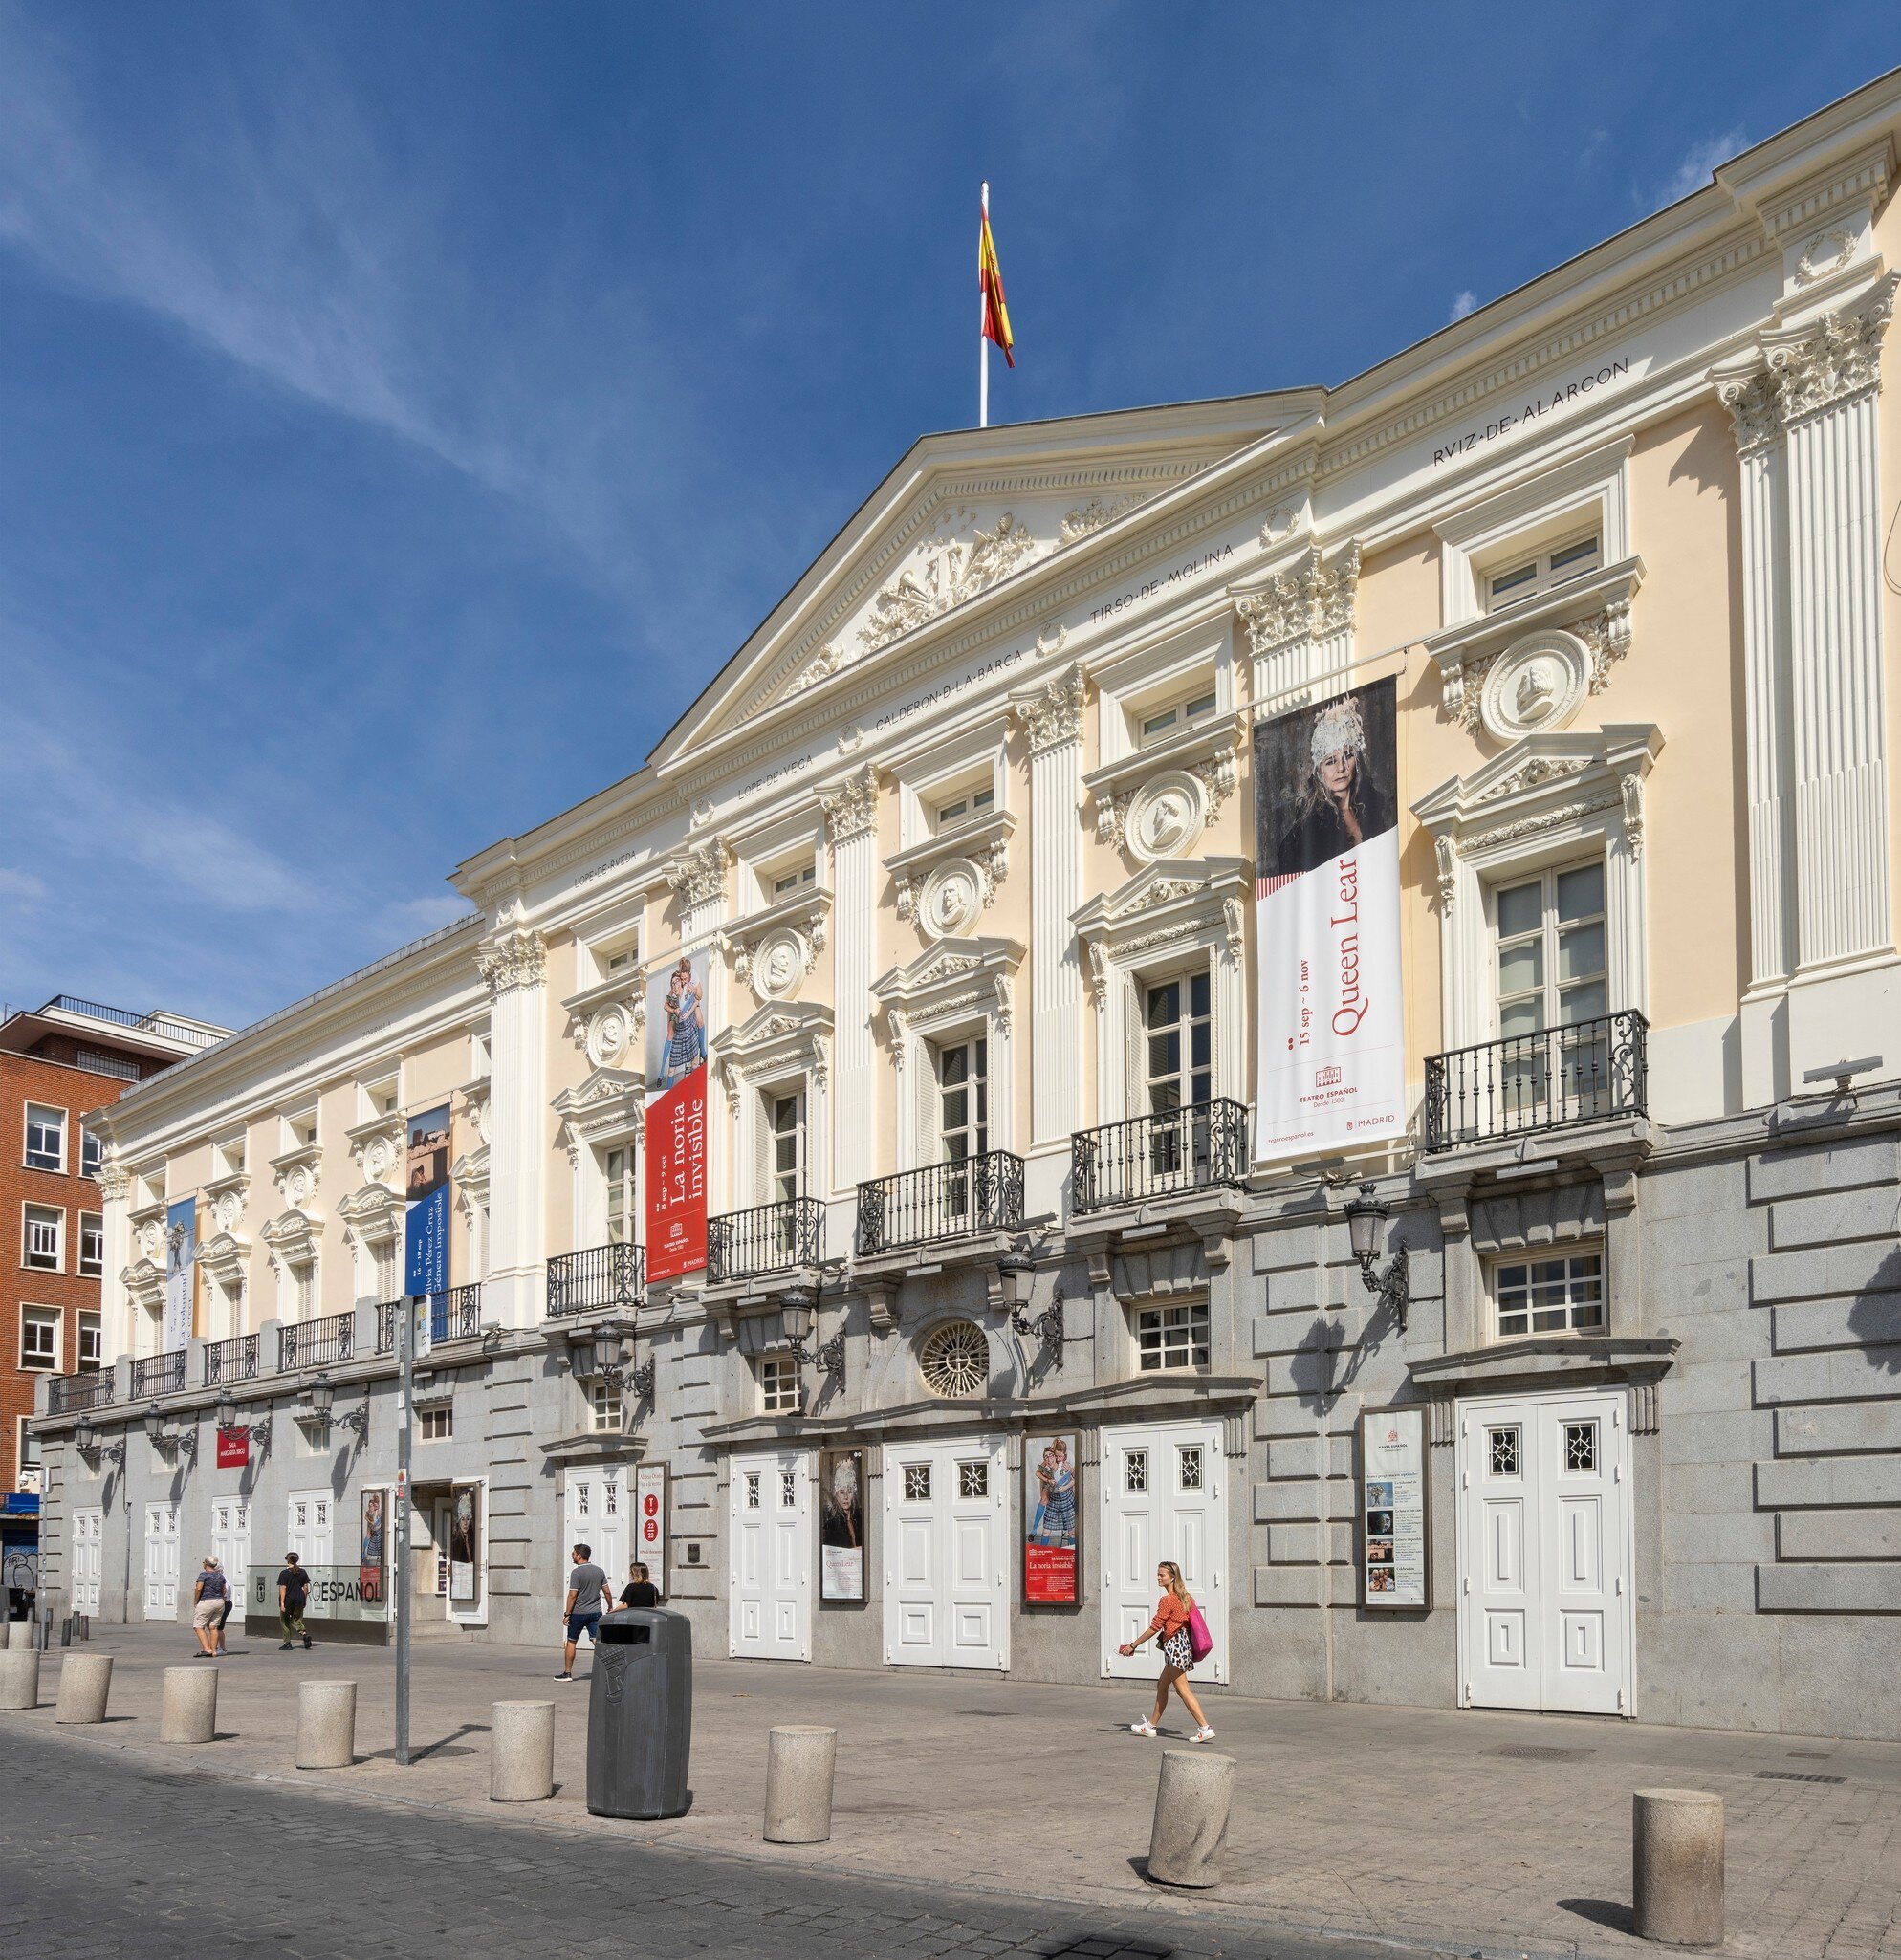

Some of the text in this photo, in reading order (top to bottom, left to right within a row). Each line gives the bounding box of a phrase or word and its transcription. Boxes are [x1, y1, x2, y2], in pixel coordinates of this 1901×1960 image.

[1485, 415, 1511, 442] DE
[1521, 357, 1629, 425] ALARCON
[1089, 544, 1235, 624] TIRSO DE MOLINA
[875, 690, 939, 731] CALDERON
[977, 650, 1023, 682] BARCA
[1330, 859, 1369, 1037] Queen Lear
[1300, 959, 1310, 982] nov
[1299, 984, 1310, 992] 6
[1300, 1008, 1314, 1030] sep
[1299, 1030, 1311, 1046] 15
[1299, 1086, 1358, 1103] TEATRO ESPAÑOL
[1313, 1100, 1330, 1108] Desde
[1358, 1114, 1395, 1128] MADRID
[670, 1101, 686, 1207] La noria
[688, 1098, 704, 1200] invisible
[426, 1206, 434, 1235] Cruz
[425, 1237, 433, 1265] Pérez
[433, 1192, 445, 1293] Género imposible
[648, 1497, 654, 1508] T
